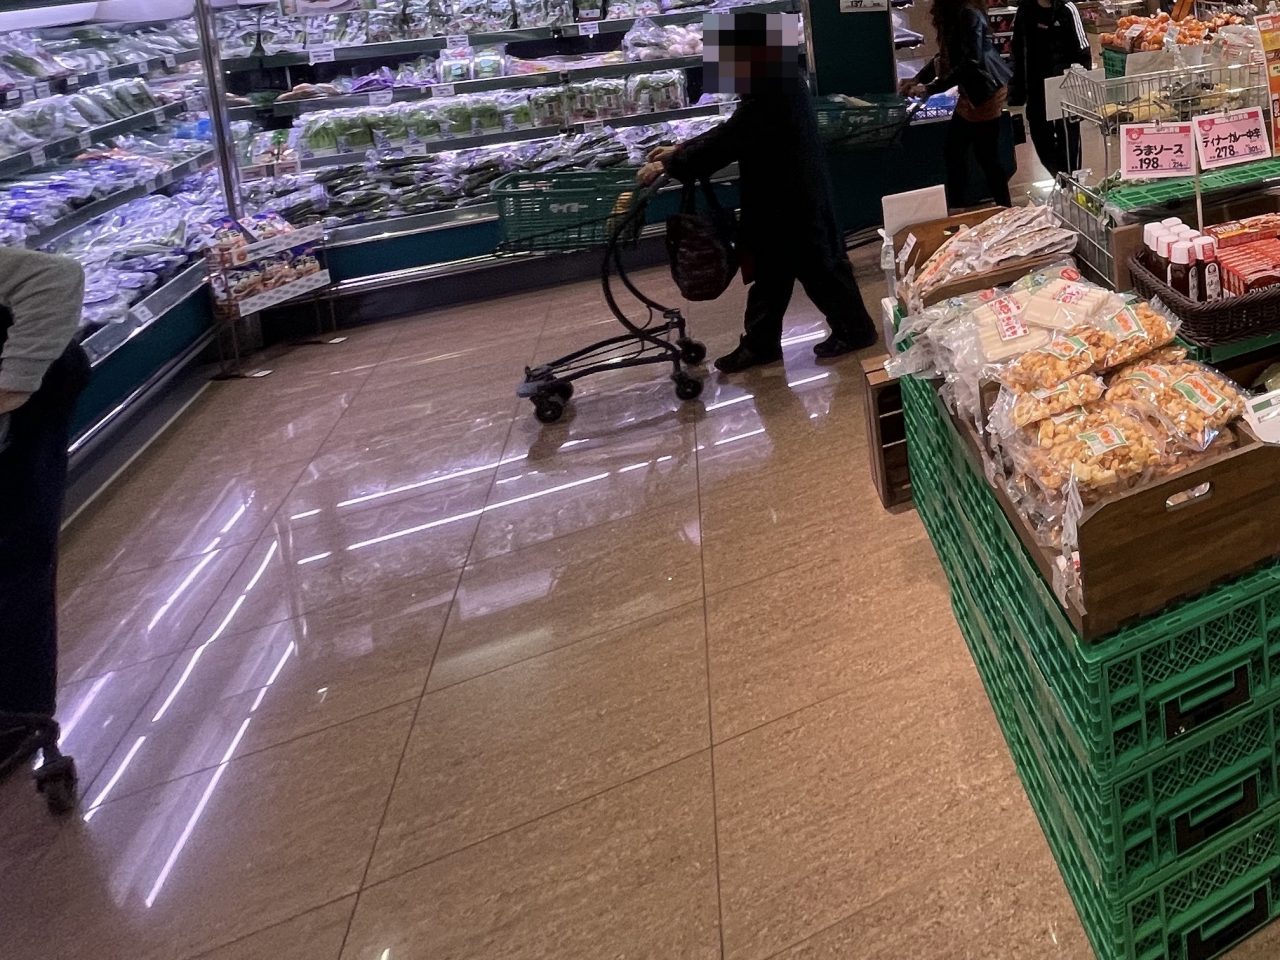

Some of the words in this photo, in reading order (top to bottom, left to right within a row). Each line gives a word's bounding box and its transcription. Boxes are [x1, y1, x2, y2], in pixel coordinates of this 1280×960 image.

[1132, 143, 1184, 157] うまソース
[1215, 145, 1237, 159] 278
[1138, 157, 1160, 170] 198
